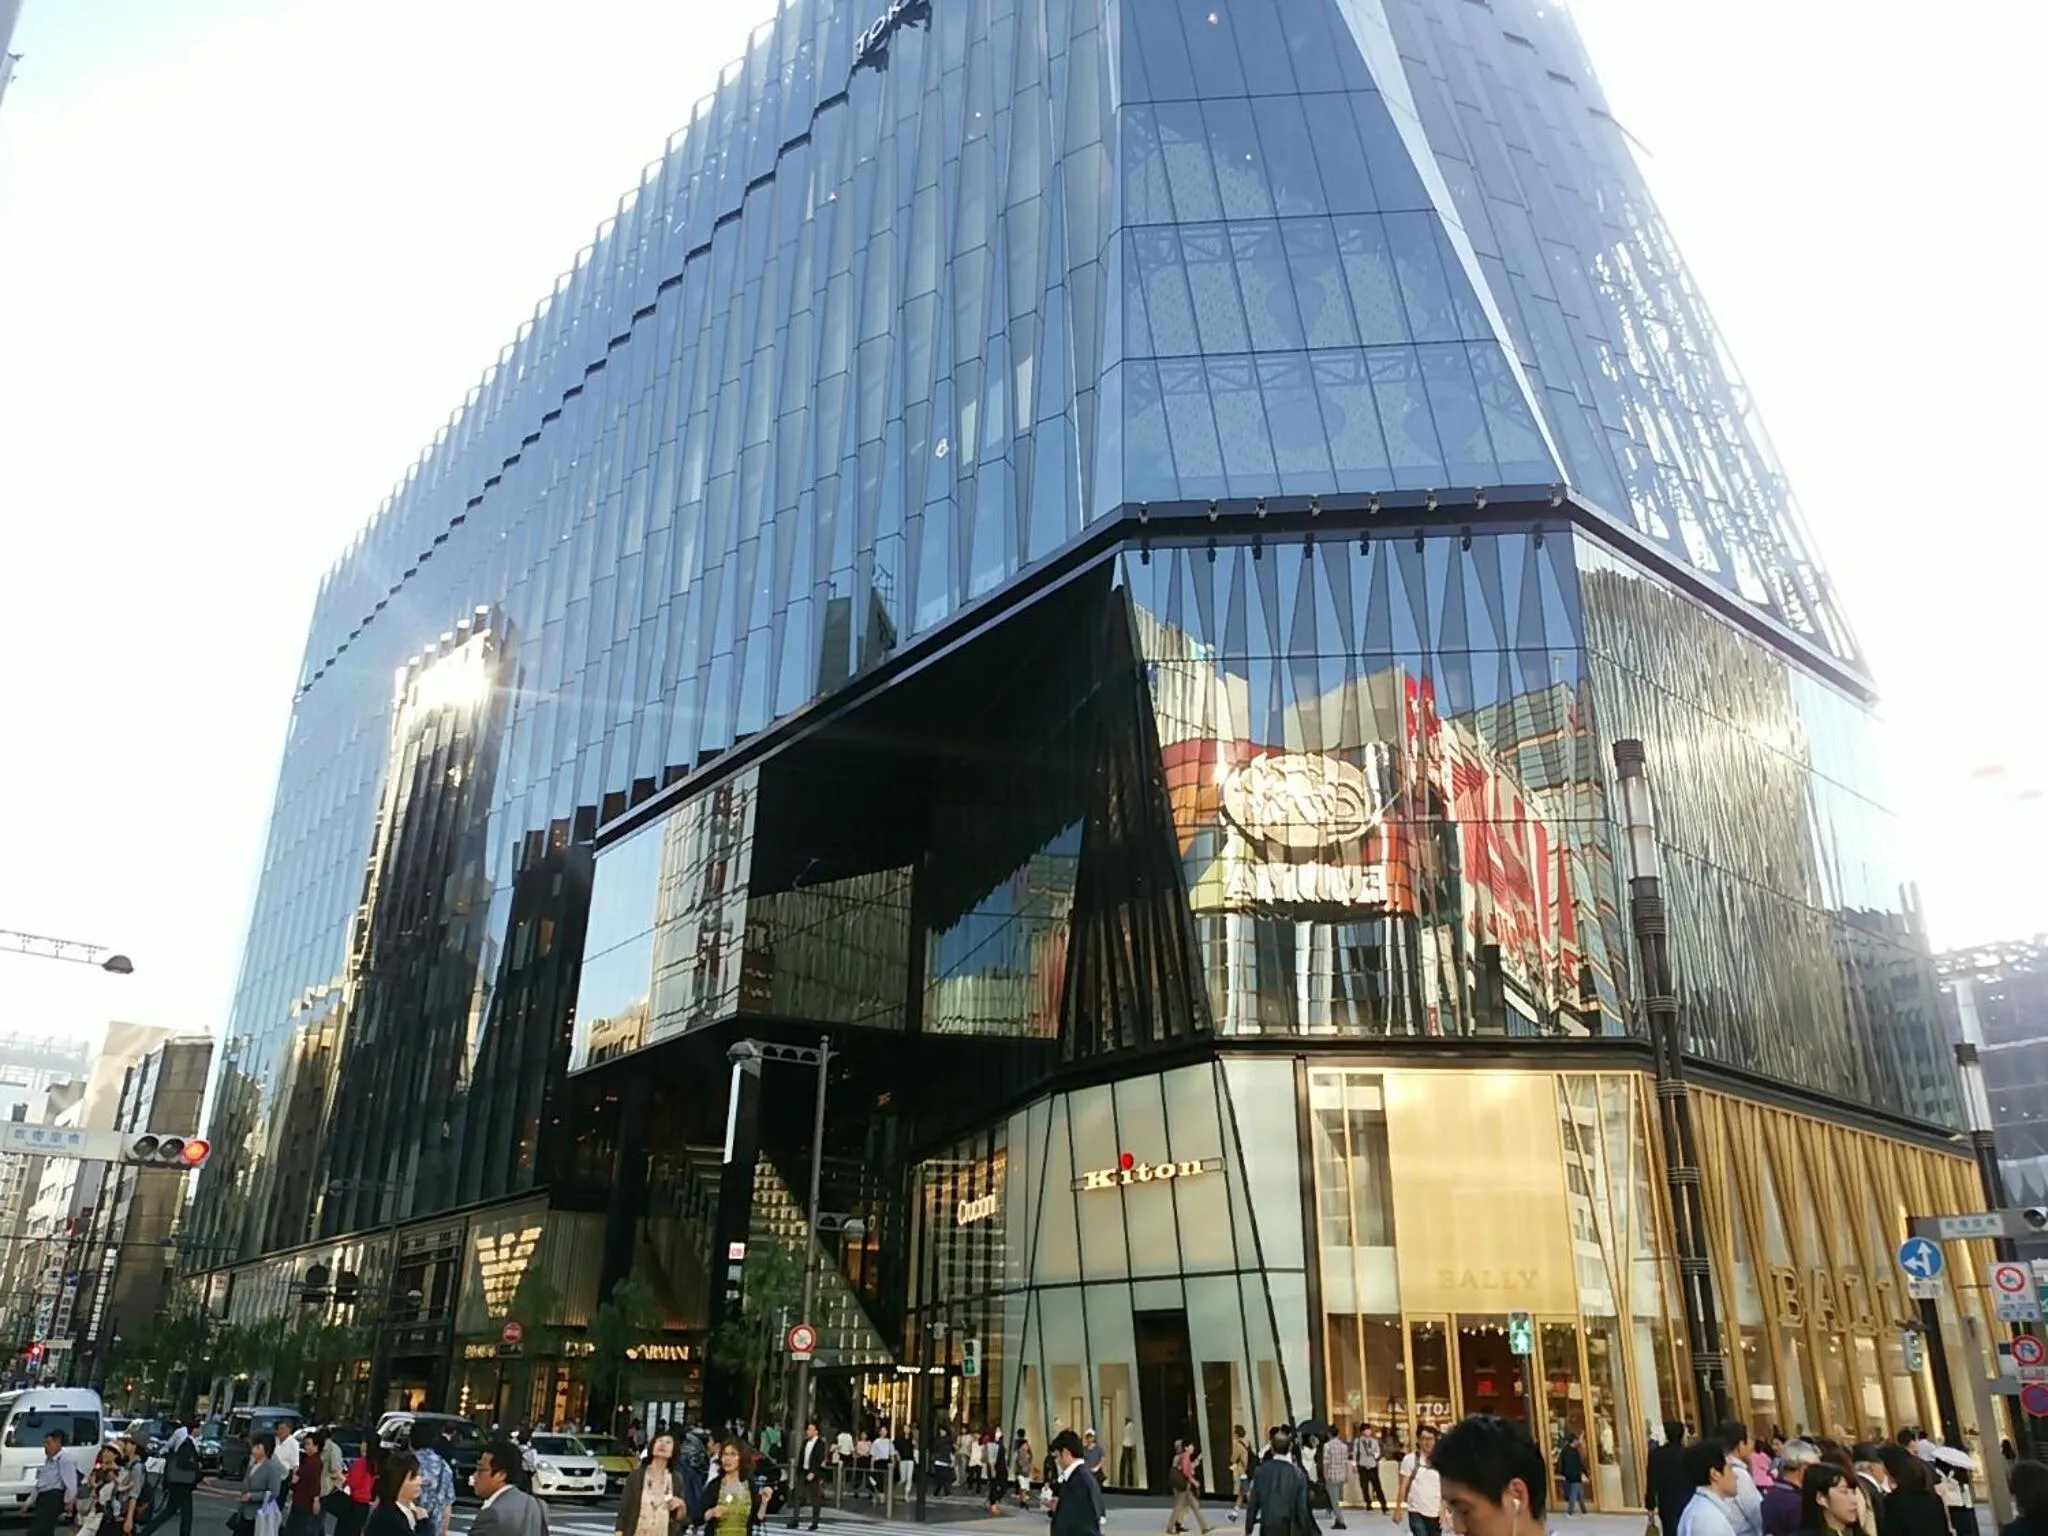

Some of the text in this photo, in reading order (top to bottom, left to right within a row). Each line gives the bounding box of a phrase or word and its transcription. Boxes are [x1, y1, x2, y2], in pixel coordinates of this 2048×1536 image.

[1083, 1152, 1204, 1191] Kiton
[1437, 1268, 1539, 1290] BALLY
[1768, 1264, 1908, 1338] BALL
